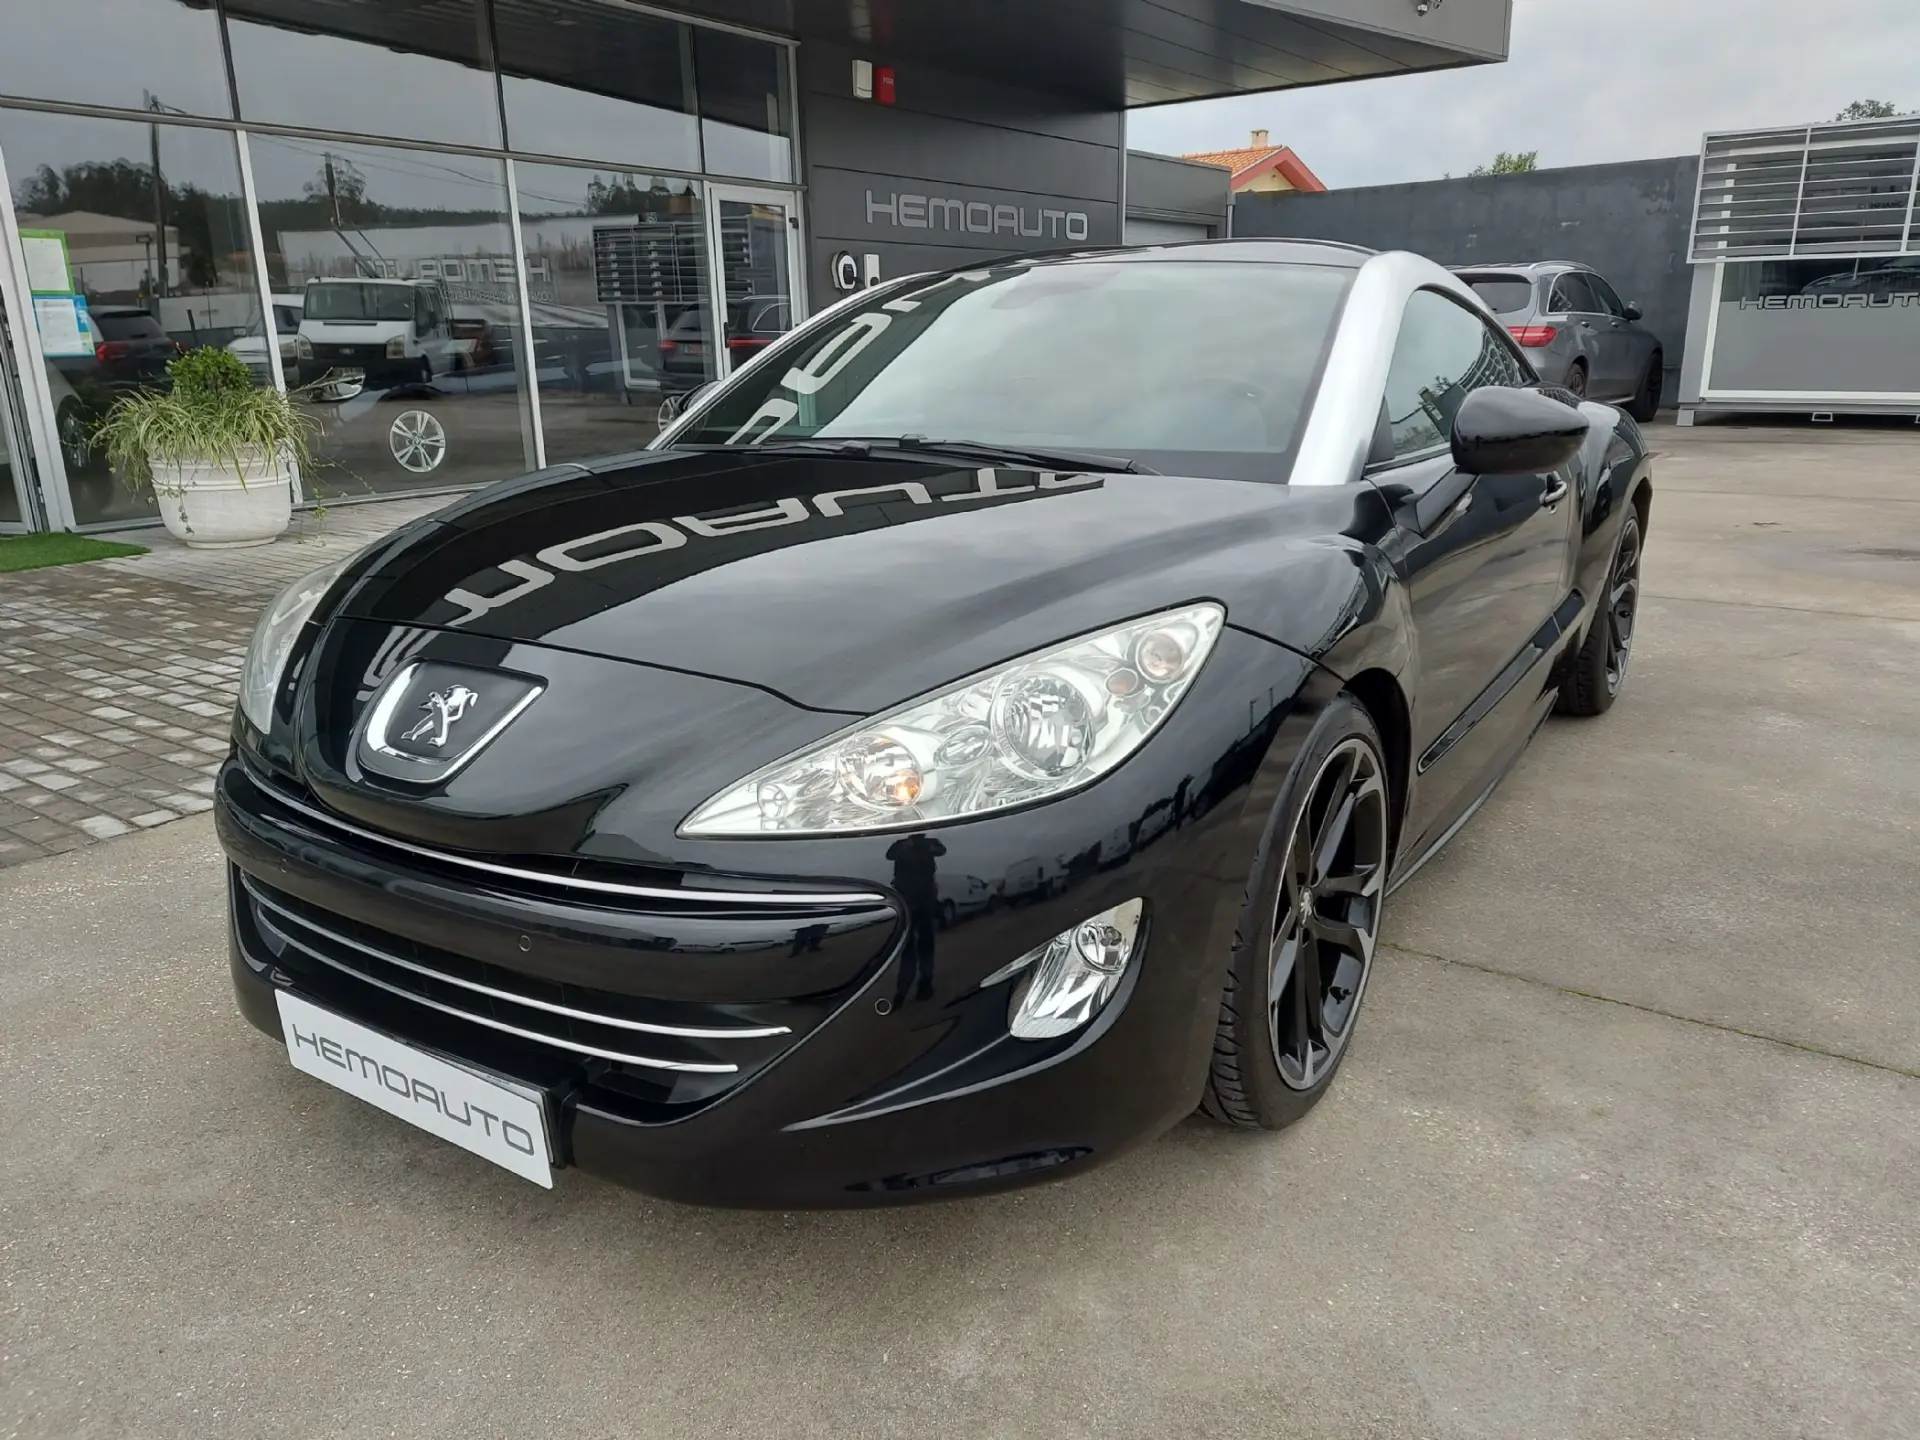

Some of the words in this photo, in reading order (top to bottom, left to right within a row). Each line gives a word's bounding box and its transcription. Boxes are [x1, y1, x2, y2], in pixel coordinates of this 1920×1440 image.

[865, 189, 1088, 241] HEMOAUTO
[1740, 292, 1920, 310] HEMOAUT
[292, 1023, 535, 1156] HEMOAUTO
